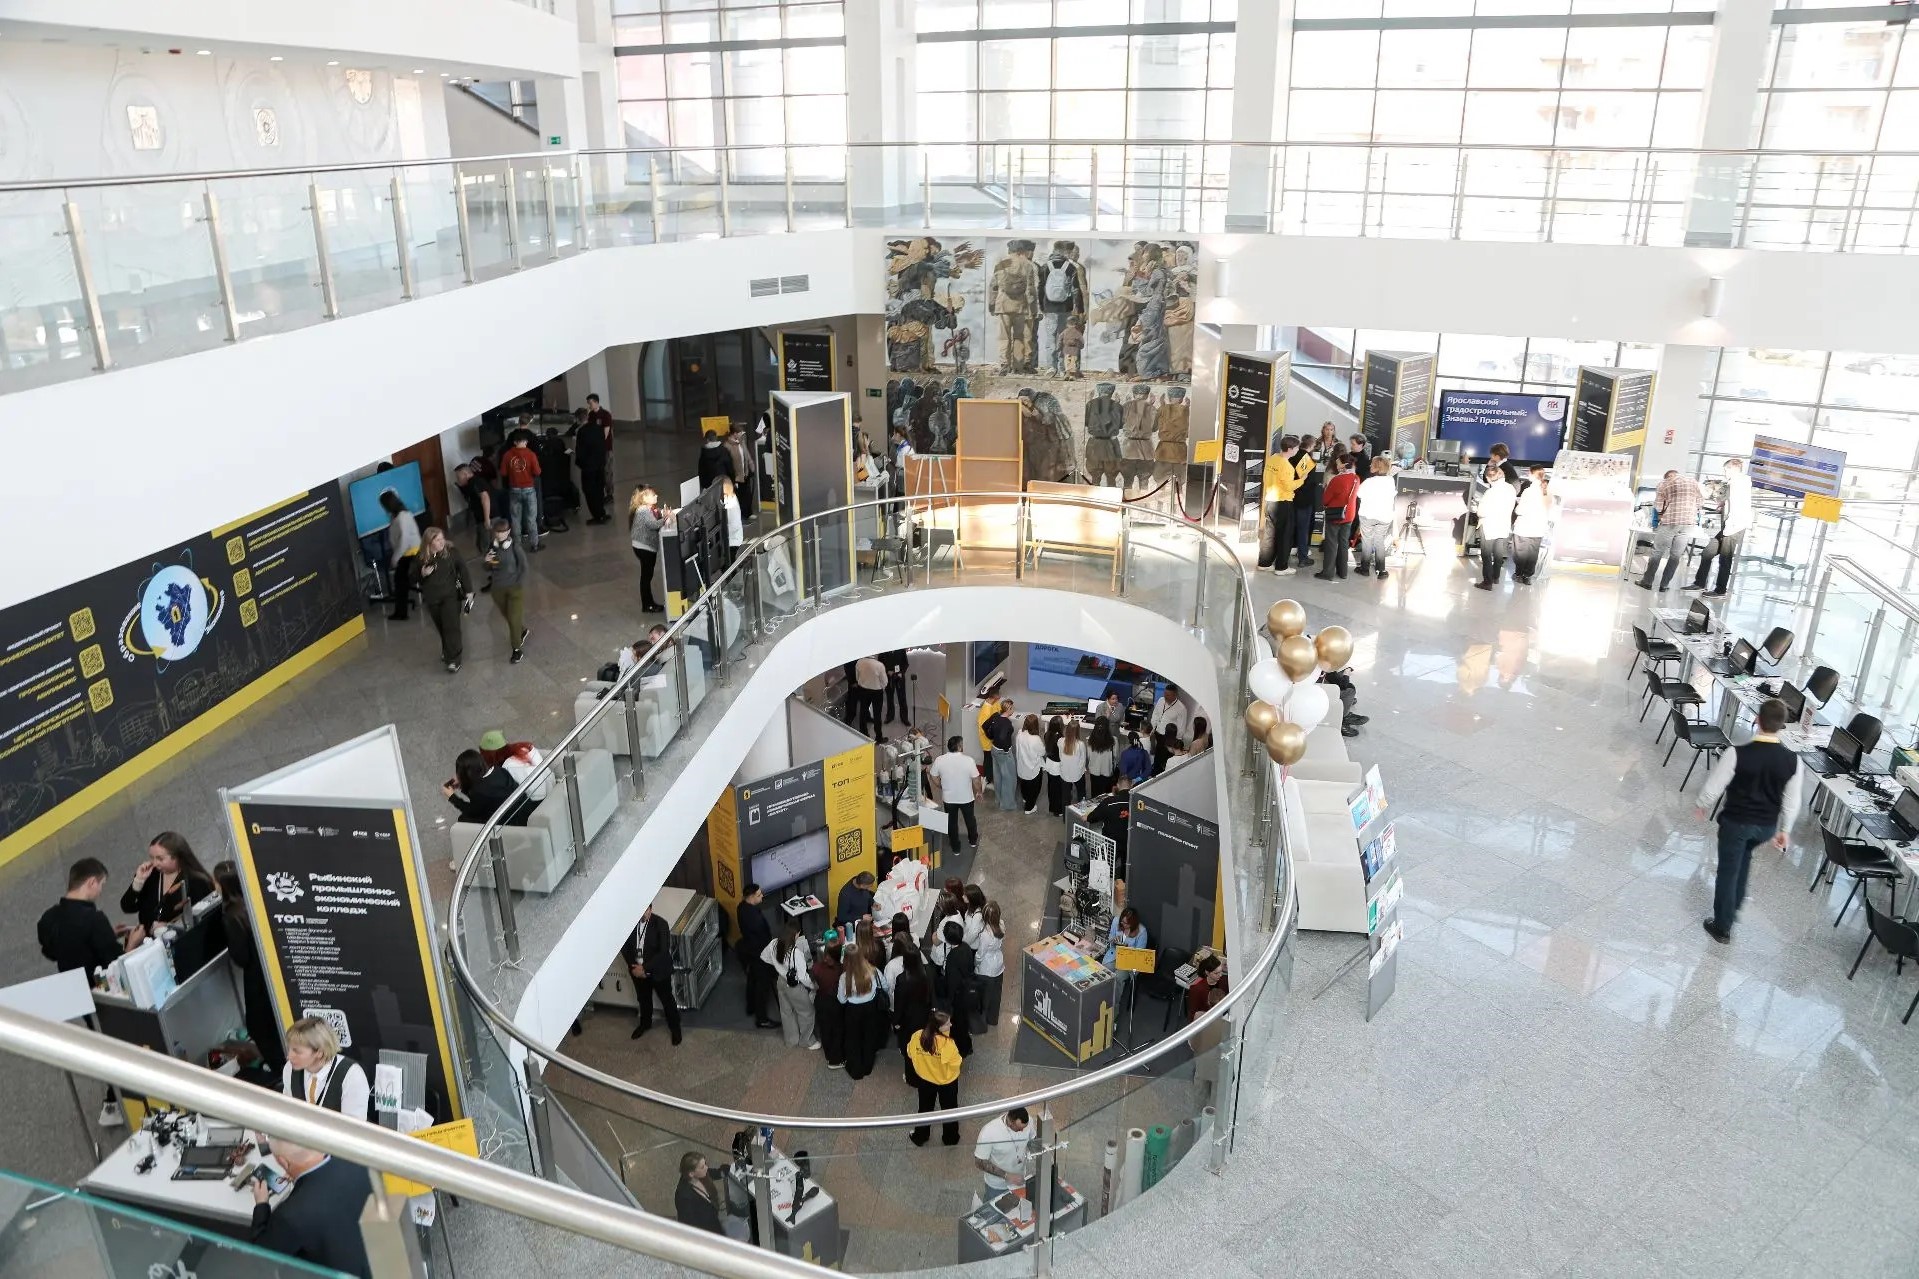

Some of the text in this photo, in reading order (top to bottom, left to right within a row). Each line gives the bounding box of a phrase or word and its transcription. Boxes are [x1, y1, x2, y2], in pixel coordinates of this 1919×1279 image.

[1447, 397, 1498, 406] Ярославский
[1446, 406, 1528, 417] градостроительный:
[1445, 415, 1517, 426] Знаешь? Проверь!
[832, 777, 850, 788] ТОП
[309, 873, 373, 884] Рыбинский
[311, 884, 396, 896] промышленно-
[314, 896, 401, 908] экономический
[316, 905, 368, 915] колледж
[274, 914, 304, 924] ТОП
